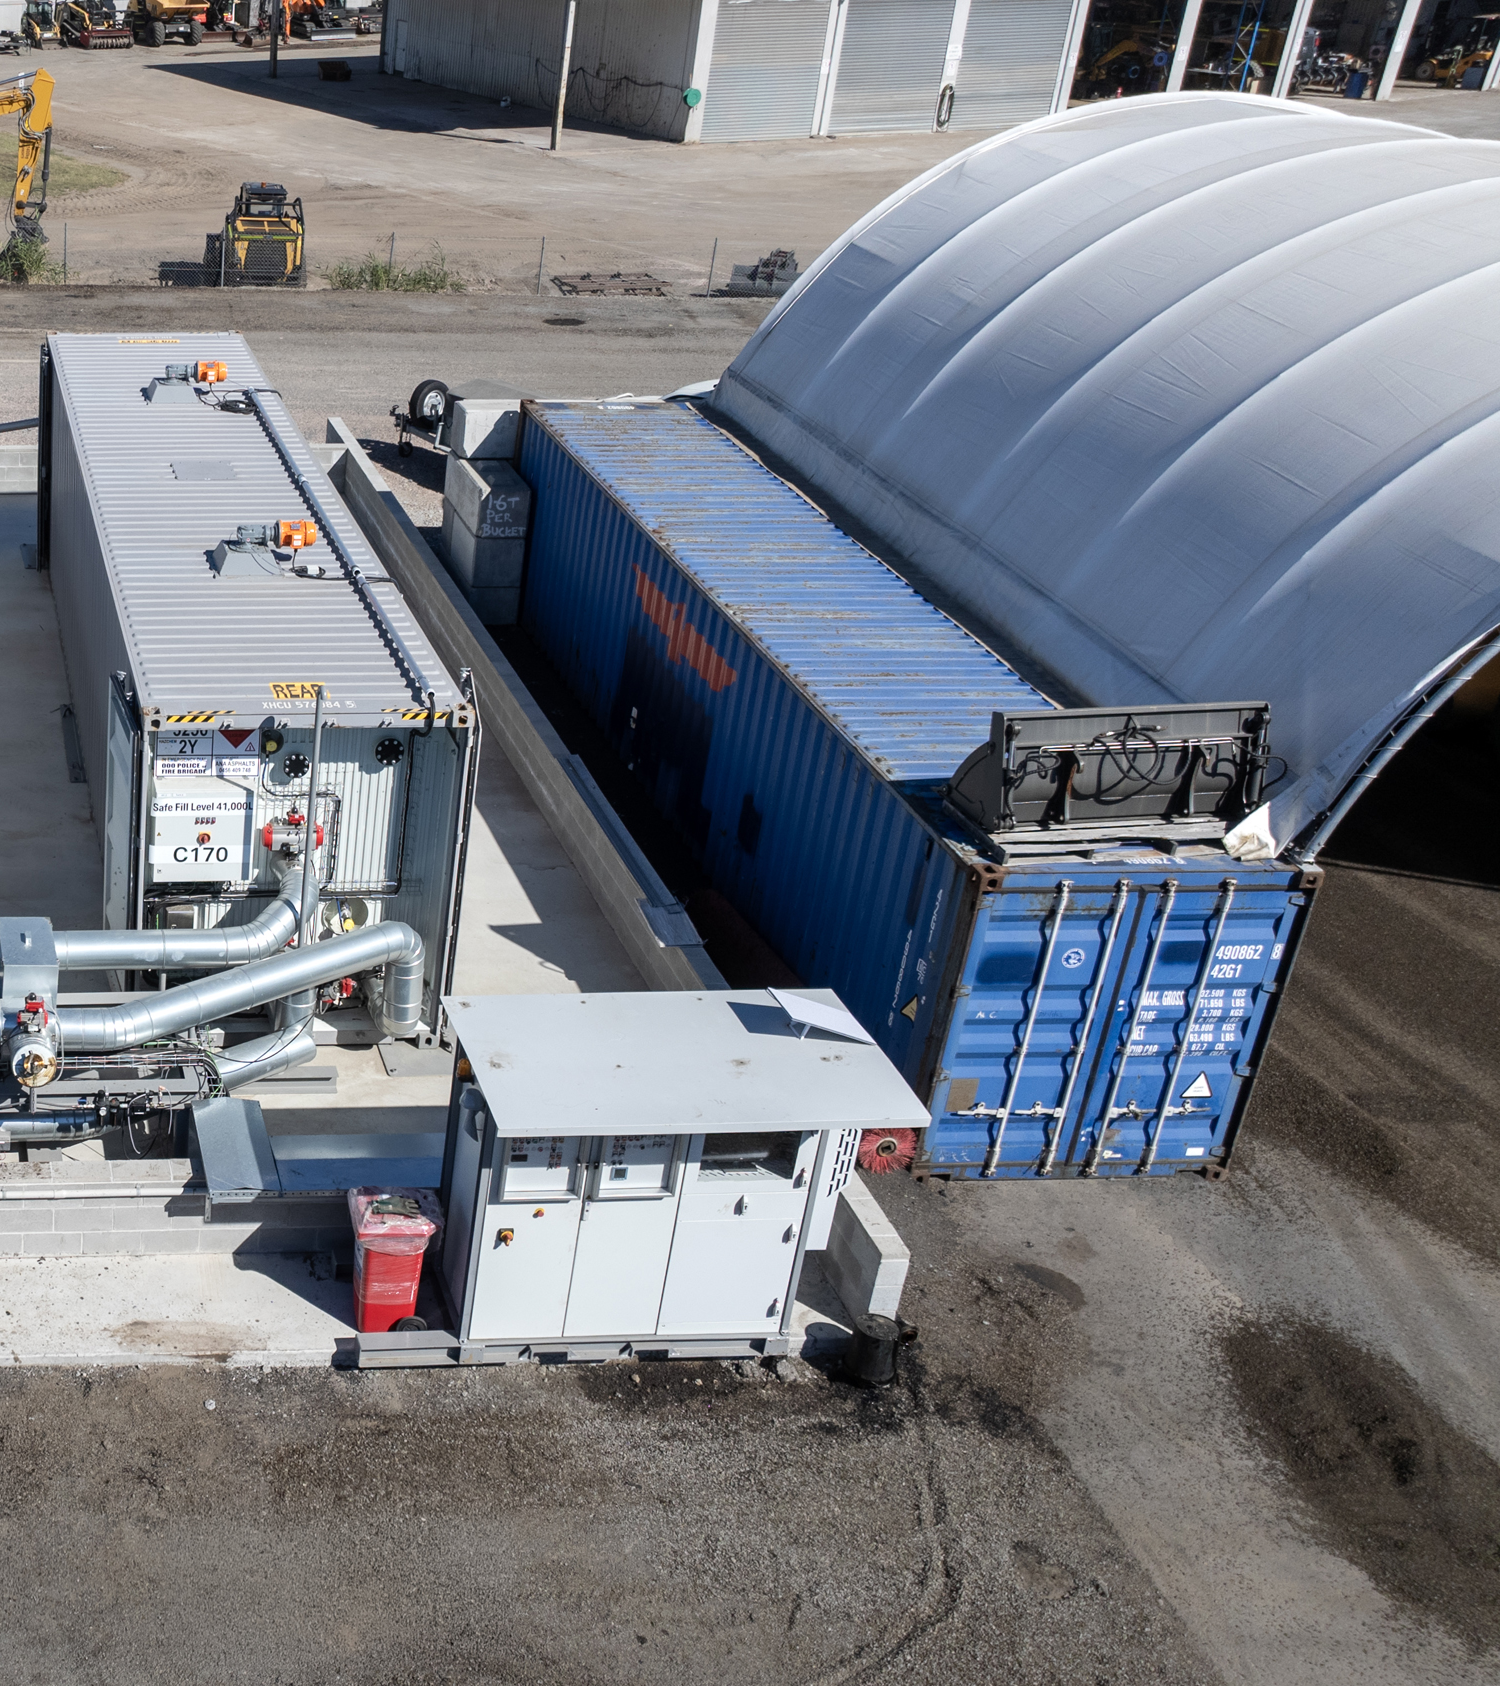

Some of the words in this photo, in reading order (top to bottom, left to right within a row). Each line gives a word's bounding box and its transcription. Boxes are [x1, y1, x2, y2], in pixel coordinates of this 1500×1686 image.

[486, 510, 512, 523] PER
[481, 524, 526, 537] BUCKET
[179, 740, 198, 753] 2Y
[153, 803, 173, 812] Safe
[175, 802, 188, 811] Fill
[191, 802, 214, 811] Level
[216, 802, 253, 811] 41,000L
[173, 847, 228, 862] C170
[1216, 945, 1263, 960] 490862
[1271, 944, 1283, 959] 8
[1210, 964, 1242, 978] 42G1
[1162, 990, 1185, 1006] GROSS
[1221, 1033, 1234, 1041] LBS
